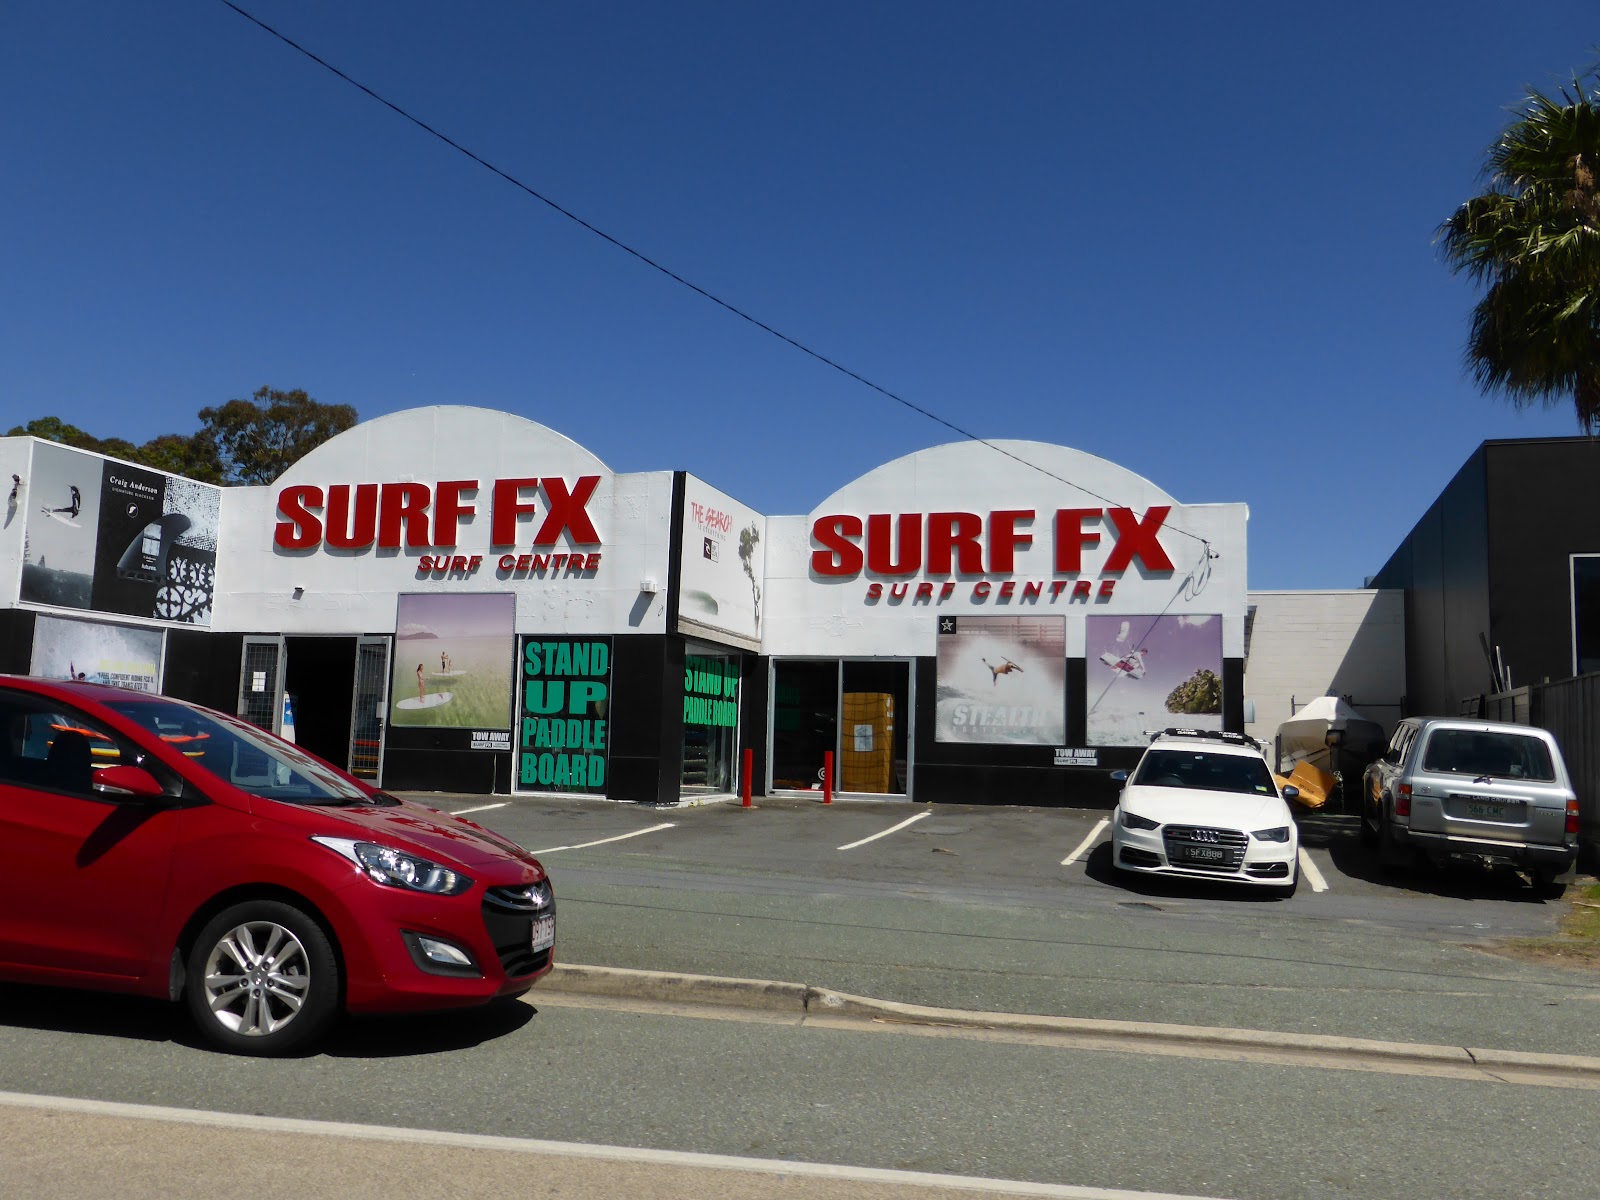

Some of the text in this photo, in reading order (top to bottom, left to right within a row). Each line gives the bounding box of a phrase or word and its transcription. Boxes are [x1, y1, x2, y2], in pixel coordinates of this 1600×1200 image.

[109, 476, 158, 494] Craig Anderson
[274, 475, 602, 549] SURF FX
[691, 501, 733, 533] THE SEARCH
[812, 505, 1175, 576] SURF FX
[417, 553, 602, 573] SURF CENTRE
[867, 580, 1116, 600] SURF CENTRE
[525, 641, 609, 676] STAND
[685, 655, 739, 698] STAND UP
[526, 680, 607, 715] UP
[684, 696, 737, 727] PADDLE BOARD
[472, 732, 510, 741] TOW AWAY
[522, 718, 606, 749] PADDLE
[1055, 749, 1096, 757] TOW AWAY
[521, 752, 605, 787] BOARD
[1468, 804, 1504, 816] 566 CMC
